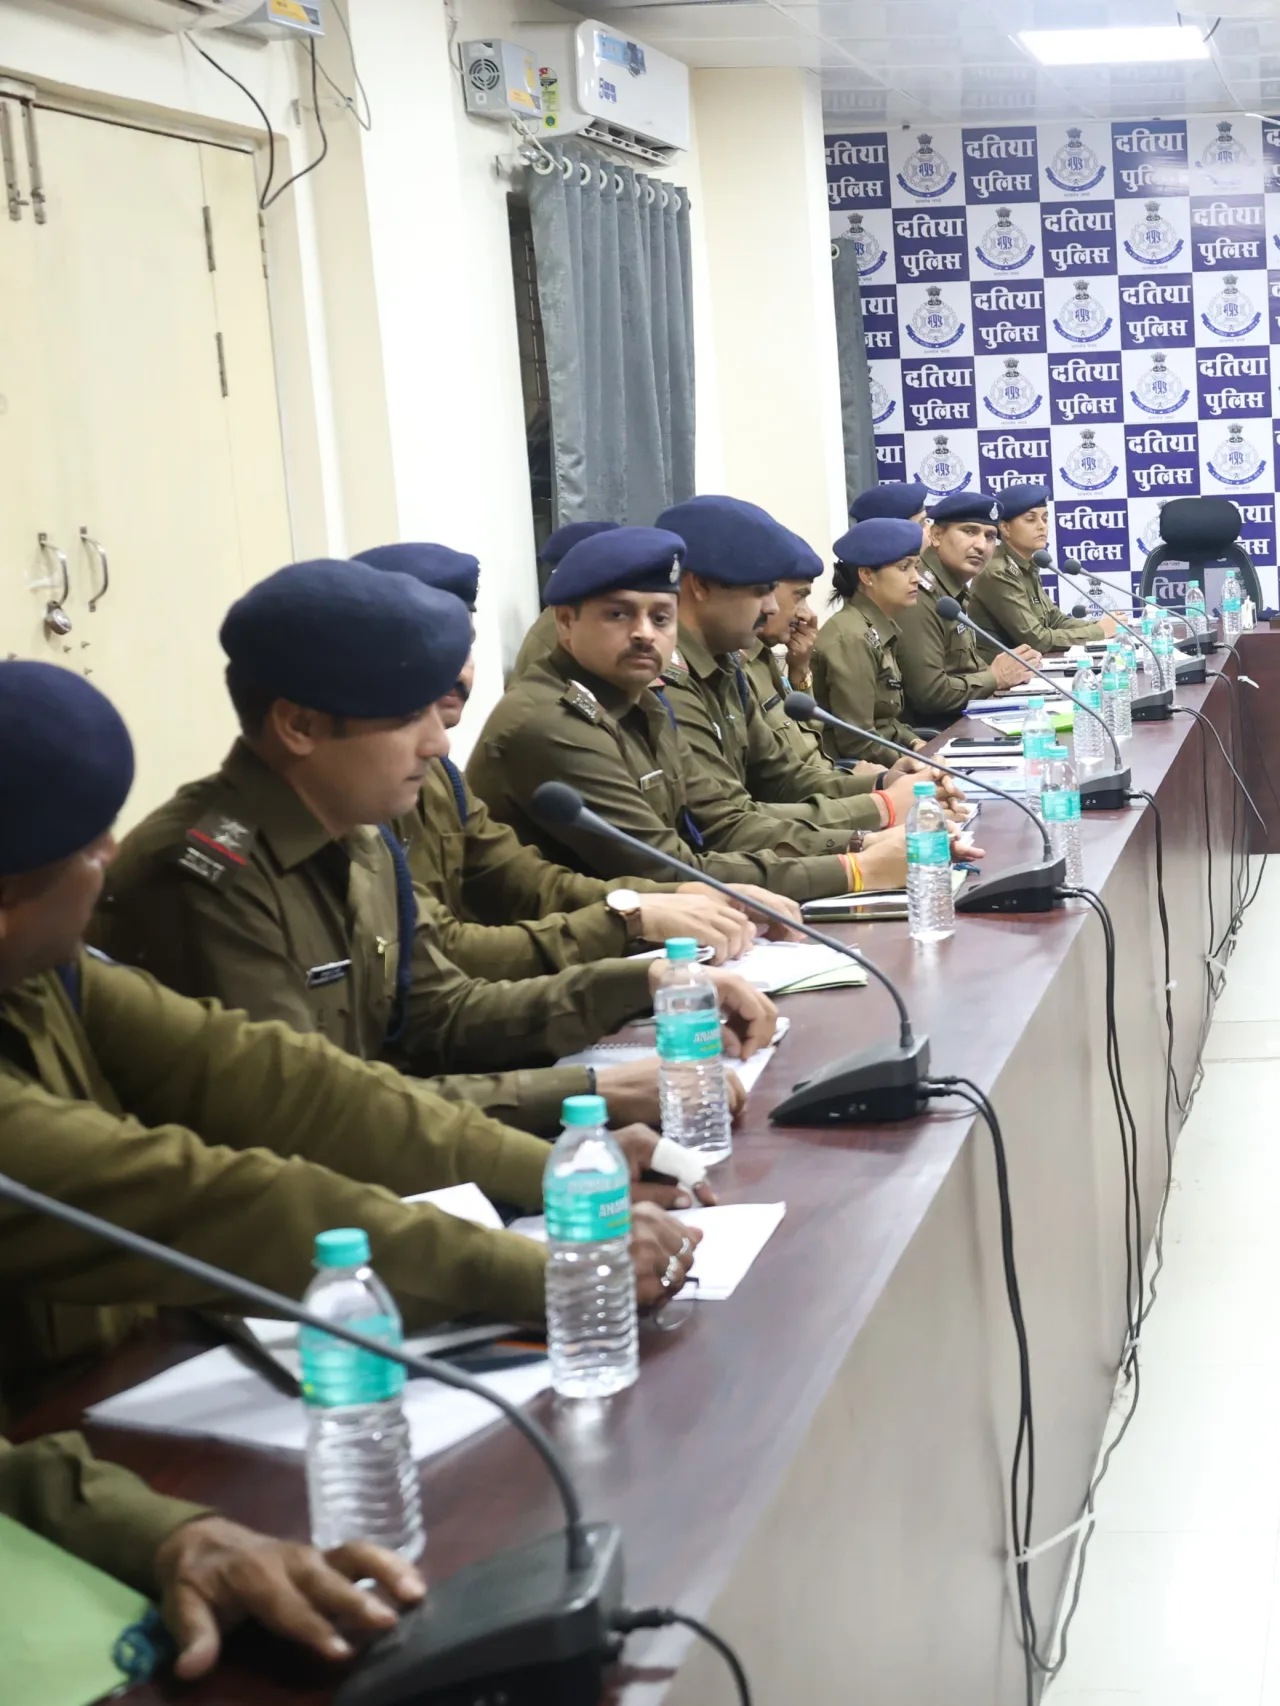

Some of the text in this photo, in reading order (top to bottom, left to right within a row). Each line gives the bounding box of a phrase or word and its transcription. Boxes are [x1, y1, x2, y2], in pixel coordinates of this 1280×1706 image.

[964, 134, 1035, 159] दतिया
[1113, 128, 1185, 153] दतिया
[970, 170, 1032, 198] पुलिस
[894, 213, 964, 238] दतिया
[1042, 207, 1113, 232] दतिया
[1191, 201, 1263, 226] दतिया
[900, 248, 962, 277] पुलिस
[1048, 243, 1110, 271] पुलिस
[1197, 237, 1260, 265] पुलिस
[972, 286, 1042, 310] दतिया
[1120, 280, 1191, 305] दतिया
[978, 321, 1039, 349] पुलिस
[1126, 315, 1188, 343] पुलिस
[902, 363, 972, 387] दतिया
[1049, 358, 1120, 382] दतिया
[1197, 352, 1268, 377] दतिया
[908, 398, 969, 425] पुलिस
[1055, 392, 1117, 420] पुलिस
[1203, 387, 1265, 415] पुलिस
[979, 434, 1049, 458] दतिया
[1126, 429, 1196, 453] दतिया
[1132, 463, 1193, 491] पुलिस
[1056, 505, 1126, 529] दतिया
